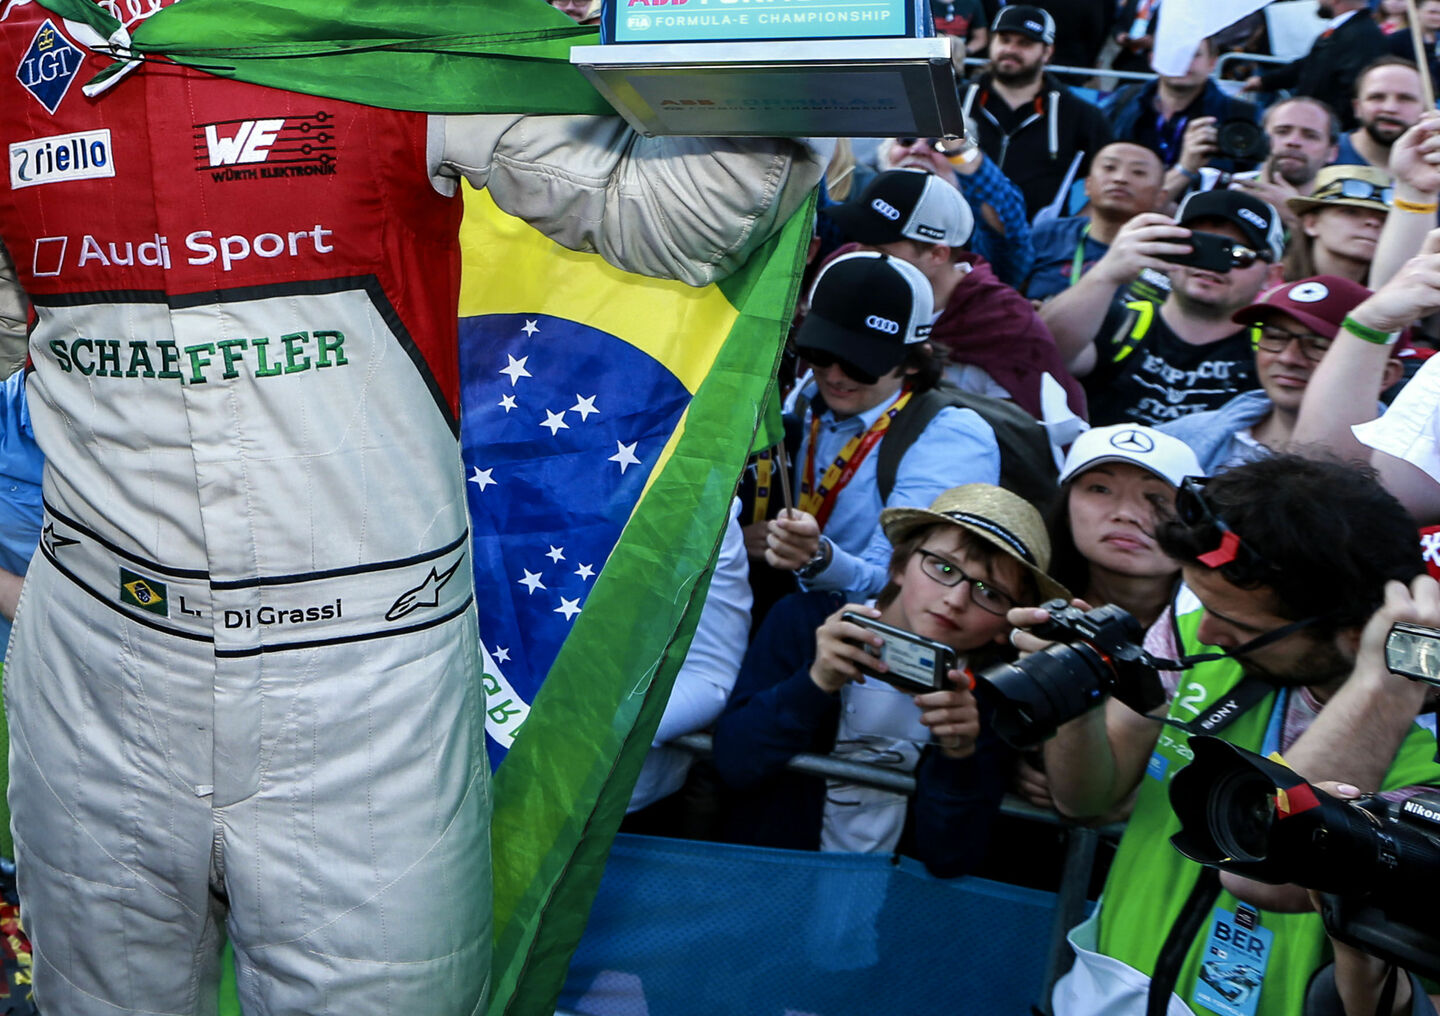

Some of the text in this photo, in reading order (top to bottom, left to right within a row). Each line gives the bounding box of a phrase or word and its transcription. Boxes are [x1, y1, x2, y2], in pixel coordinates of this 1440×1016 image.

[627, 10, 892, 29] FIA FORMULA-E CHAMPIONSHIP
[23, 46, 74, 87] LGT
[33, 140, 108, 174] riello
[204, 118, 286, 167] WE
[211, 164, 337, 183] WÜRTH ELEKTRONIK
[78, 224, 335, 272] Audi Sport
[49, 329, 349, 386] SCHAEFFLER
[179, 596, 202, 618] L.
[1200, 699, 1239, 731] SONY
[1403, 800, 1440, 823] Nikon
[1214, 920, 1266, 959] BER
